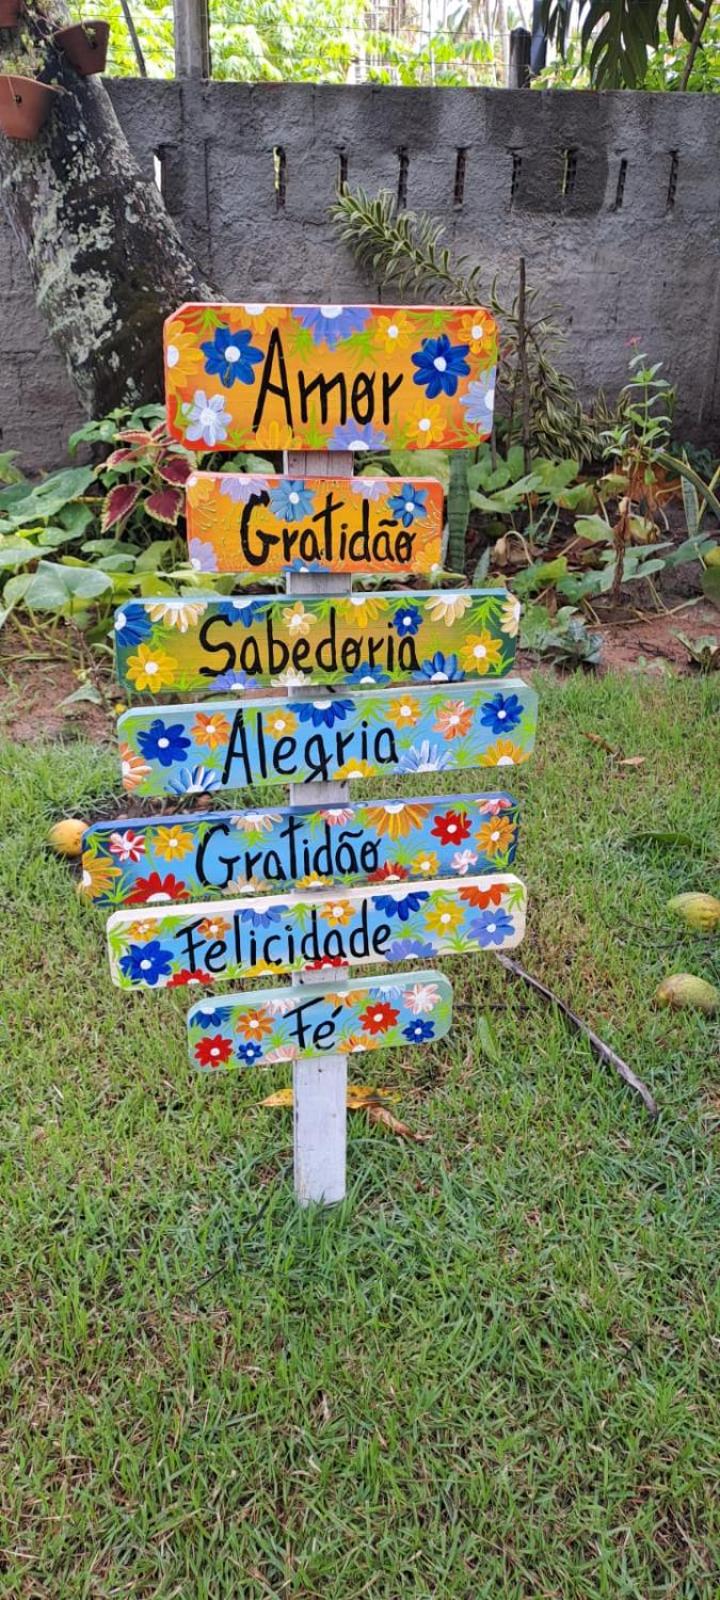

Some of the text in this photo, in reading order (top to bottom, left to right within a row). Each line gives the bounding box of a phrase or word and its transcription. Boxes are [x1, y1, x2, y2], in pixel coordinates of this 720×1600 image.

[252, 327, 403, 438] Amor
[239, 489, 416, 566] Gratidão
[199, 606, 420, 677] Sabedoria
[221, 708, 399, 784] Alegria
[195, 815, 382, 888] Gratidão
[175, 899, 392, 974] Felicidade
[283, 996, 344, 1050] Fé
